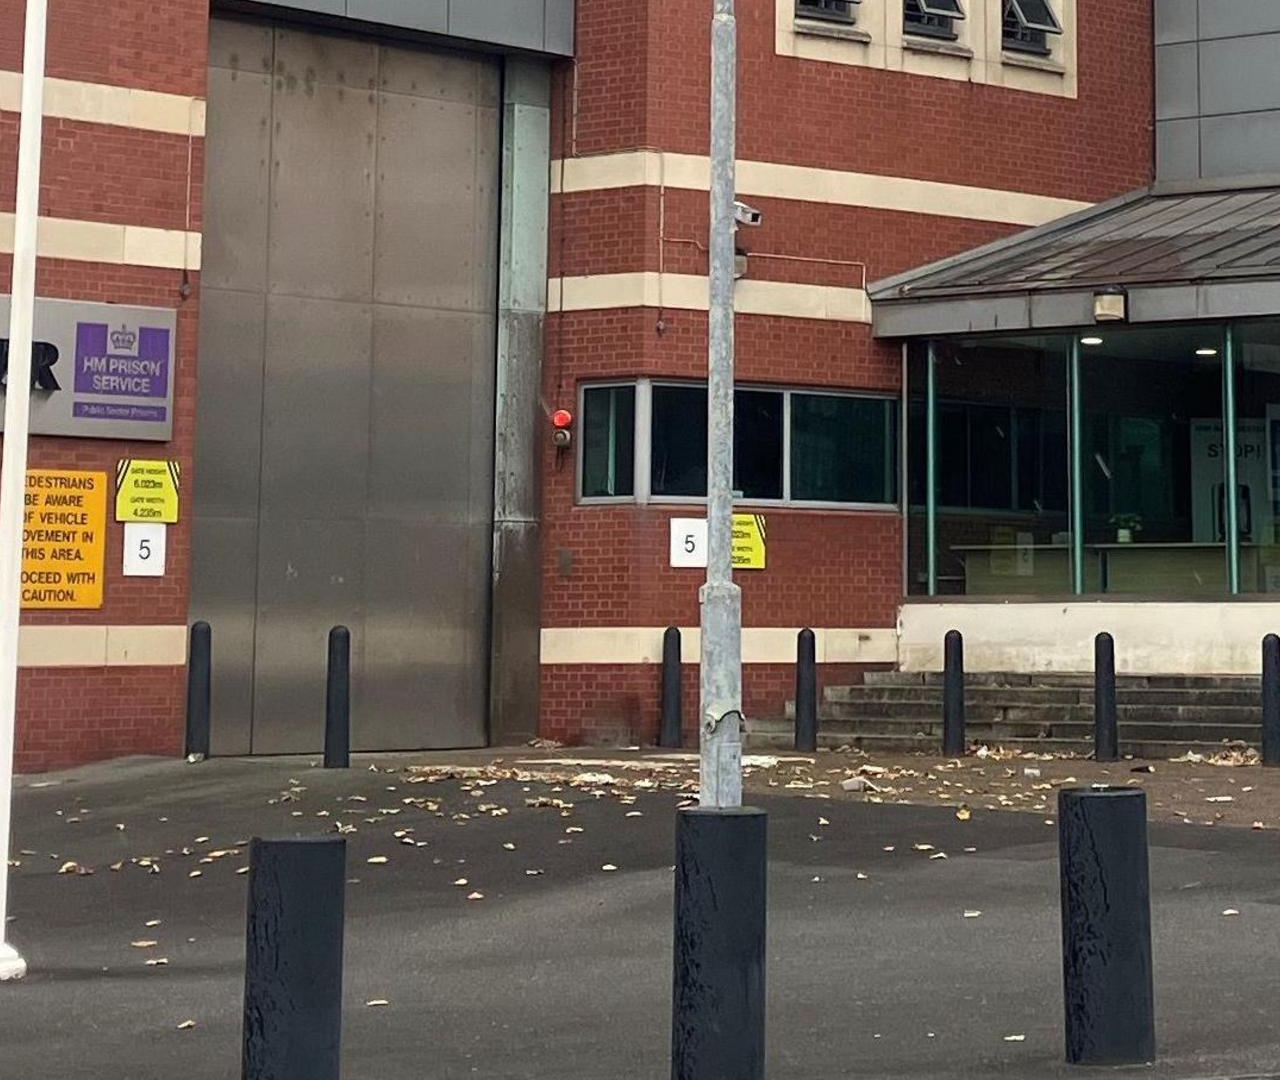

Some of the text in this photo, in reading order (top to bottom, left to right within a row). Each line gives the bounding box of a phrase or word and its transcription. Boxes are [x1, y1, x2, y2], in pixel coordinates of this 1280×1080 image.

[83, 356, 162, 376] HM PRISON
[92, 374, 151, 393] SERVICE
[1208, 443, 1261, 458] SOP!
[24, 476, 95, 490] DESTRIANS
[45, 495, 84, 508] AWARE
[40, 512, 89, 525] VEHICLE
[22, 529, 94, 543] OVEMENT IN
[138, 539, 151, 560] 5
[684, 534, 696, 553] 5
[50, 548, 85, 561] AREA.
[21, 571, 96, 585] OCEED WITH
[22, 588, 77, 602] CAUTION.
